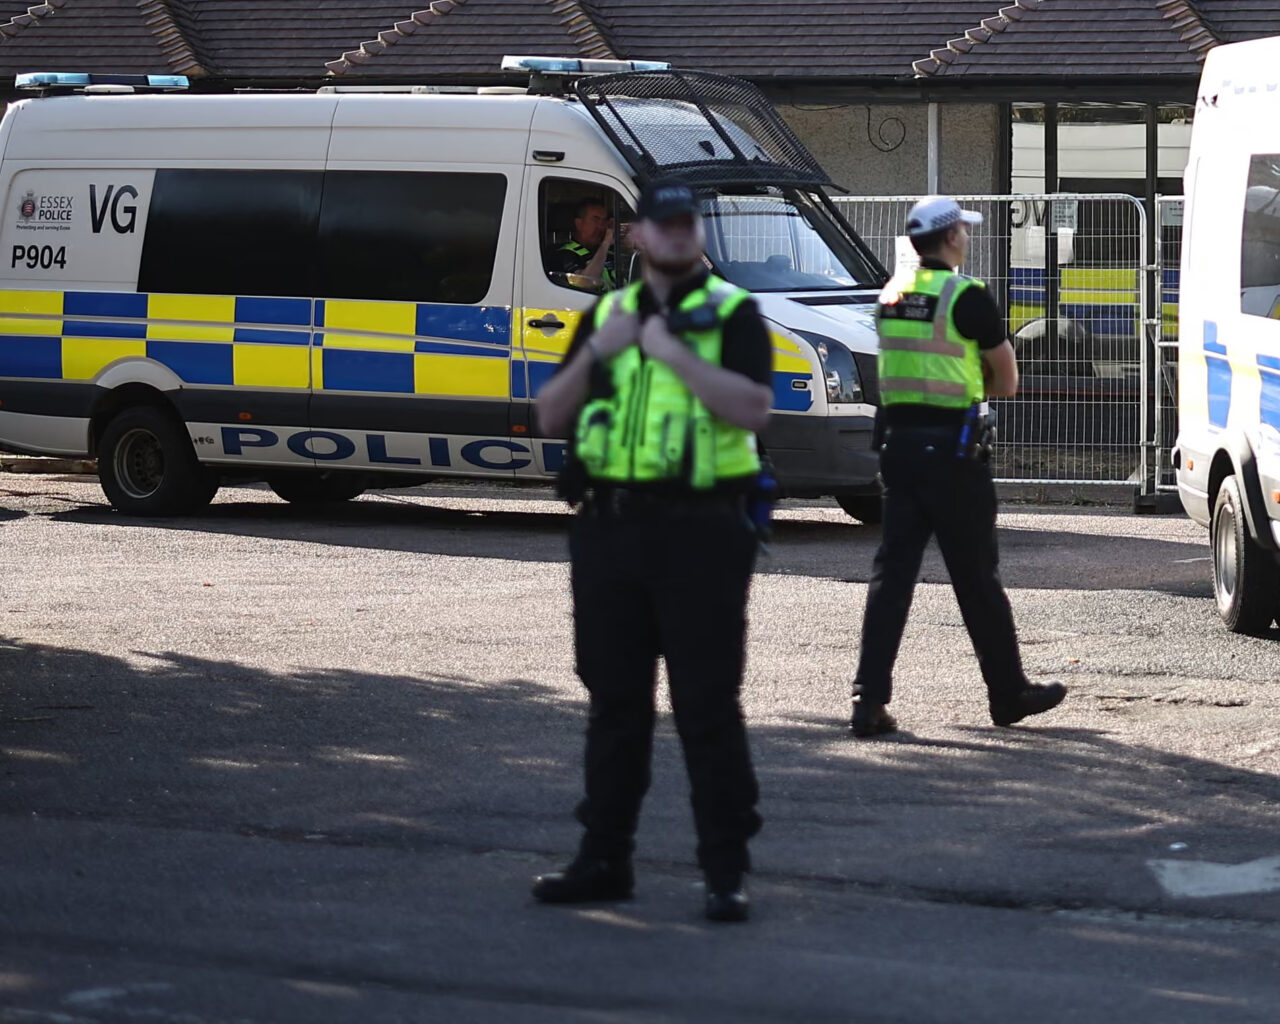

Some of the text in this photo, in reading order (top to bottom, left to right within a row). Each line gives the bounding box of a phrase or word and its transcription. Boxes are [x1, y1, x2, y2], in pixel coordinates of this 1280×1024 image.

[40, 196, 73, 209] ESSEX
[89, 184, 138, 234] VG
[38, 209, 72, 221] POLICE
[11, 244, 67, 269] P904
